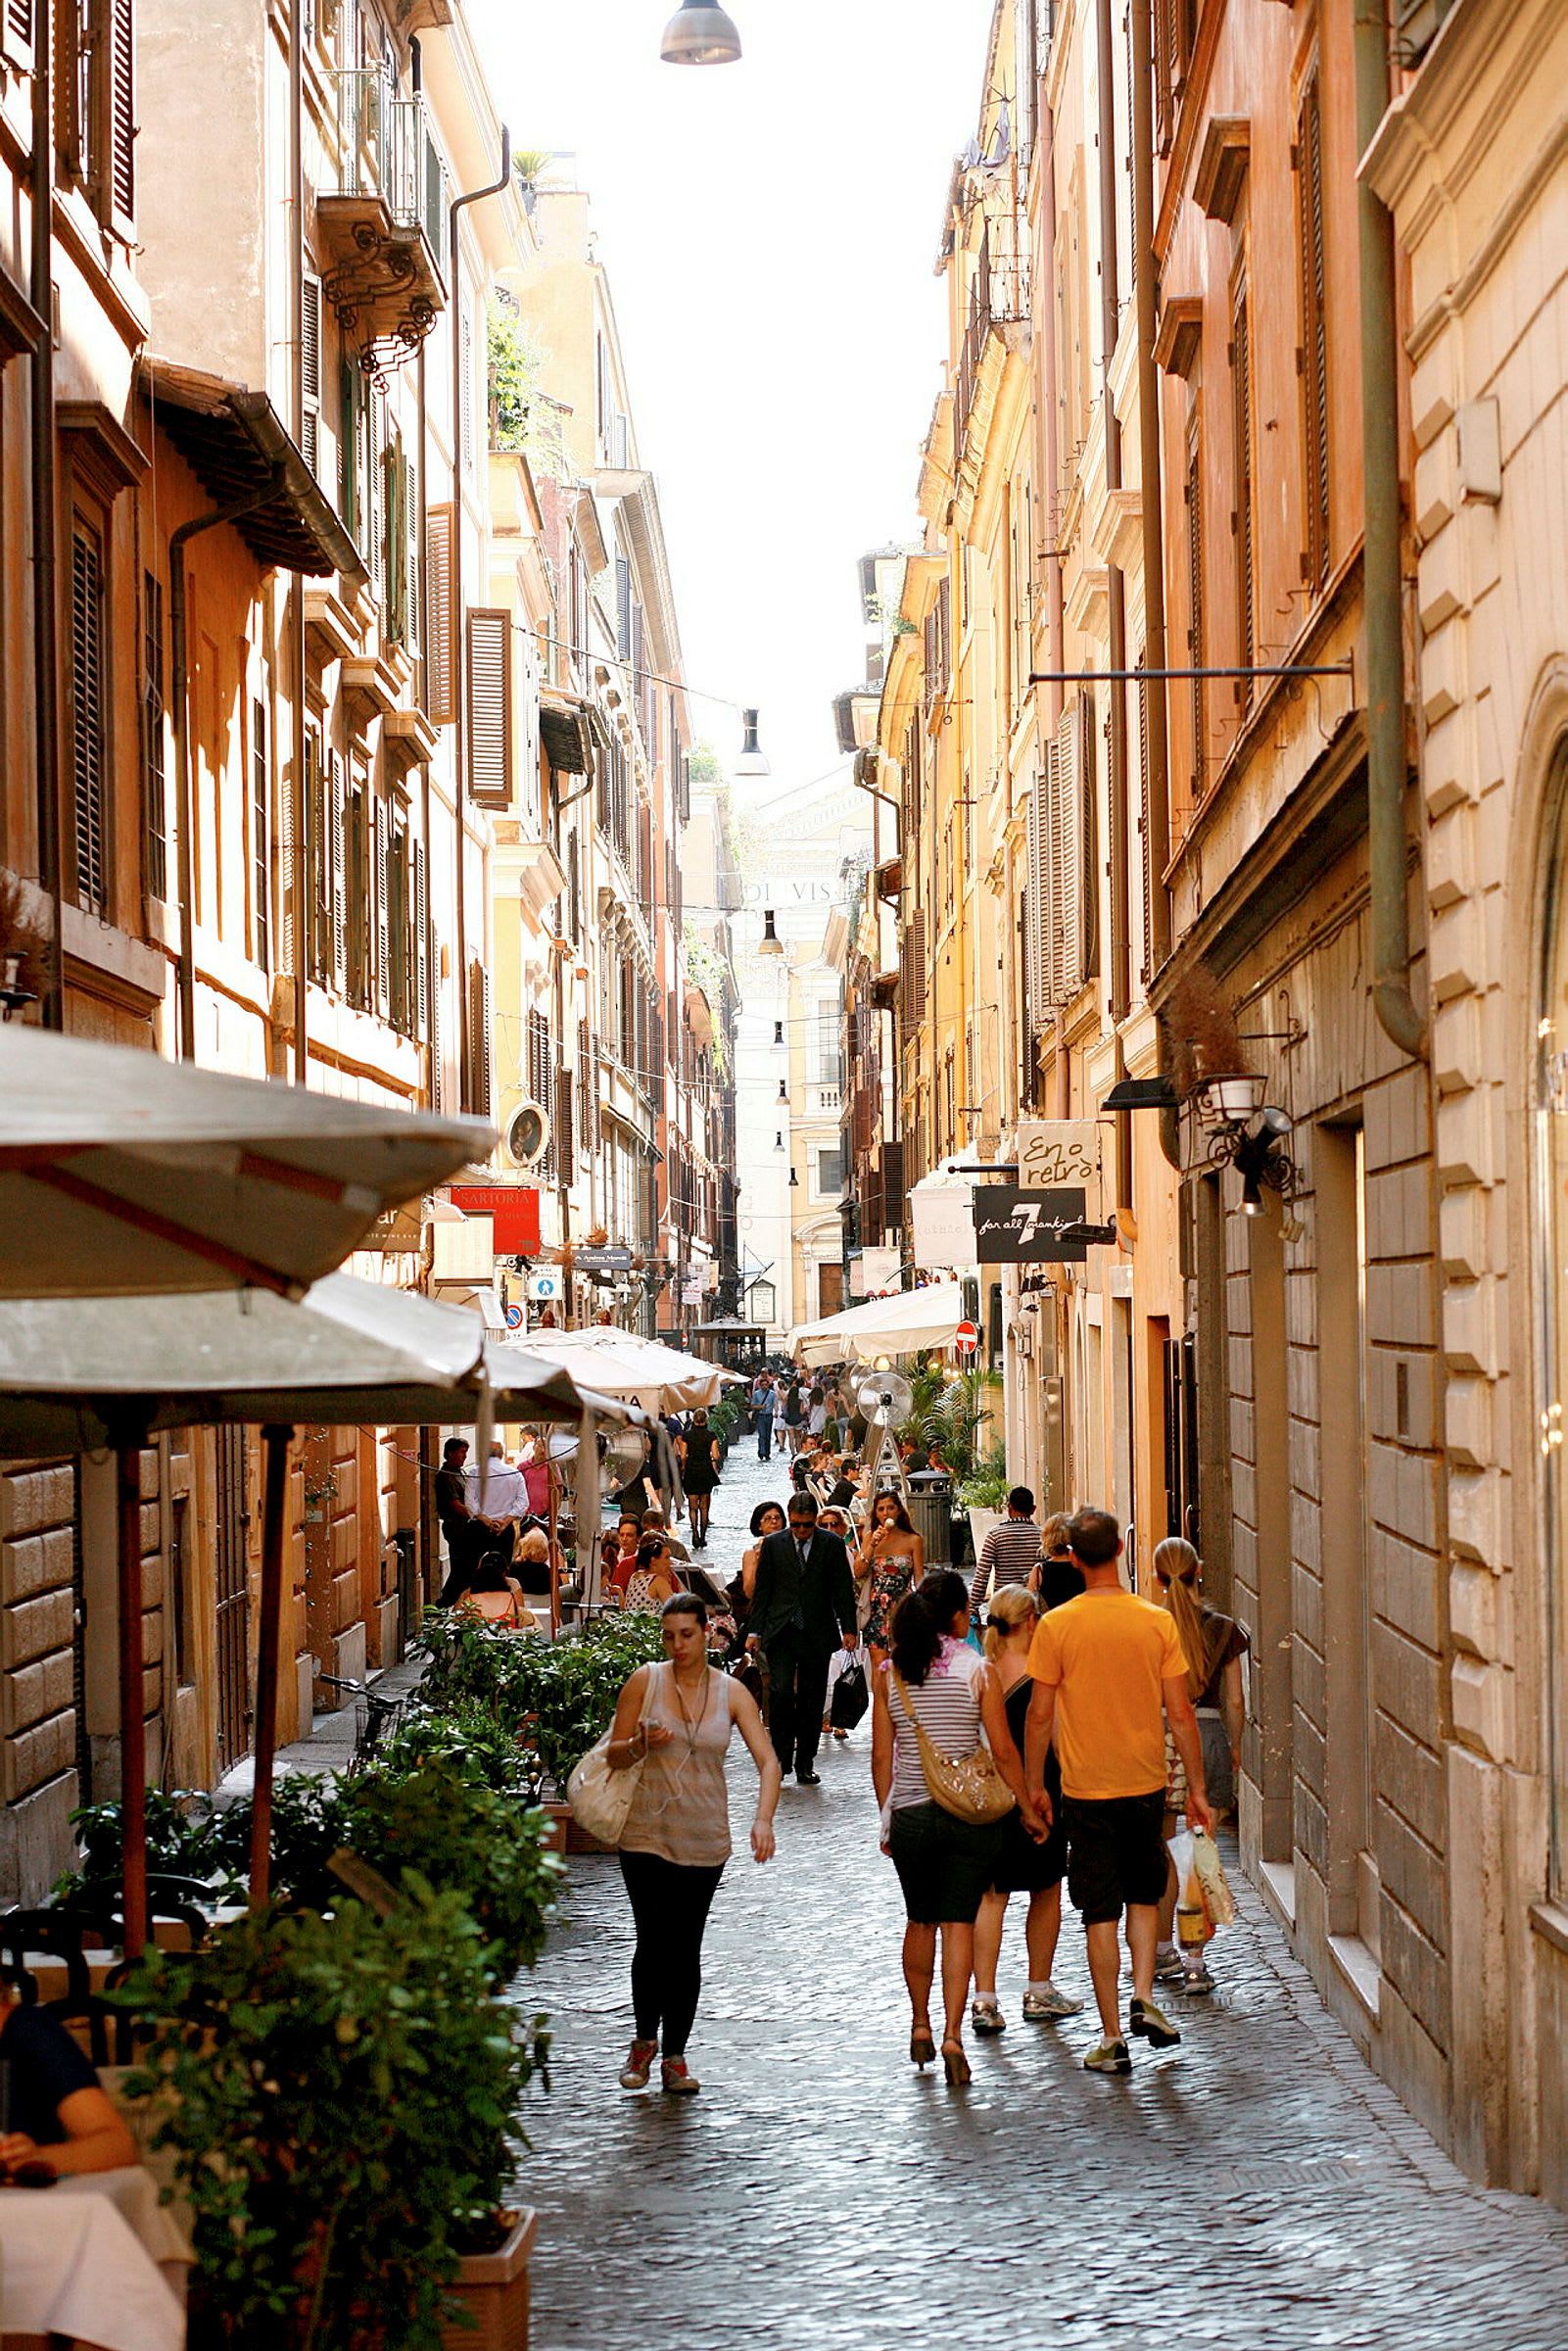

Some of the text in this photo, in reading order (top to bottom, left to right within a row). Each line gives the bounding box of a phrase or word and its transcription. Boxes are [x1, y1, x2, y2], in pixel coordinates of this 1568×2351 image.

[1027, 1158, 1092, 1184] retrò
[460, 1192, 529, 1205] SARTORIA
[979, 1219, 1001, 1235] for
[1003, 1218, 1022, 1229] all
[1011, 1203, 1042, 1245] 7
